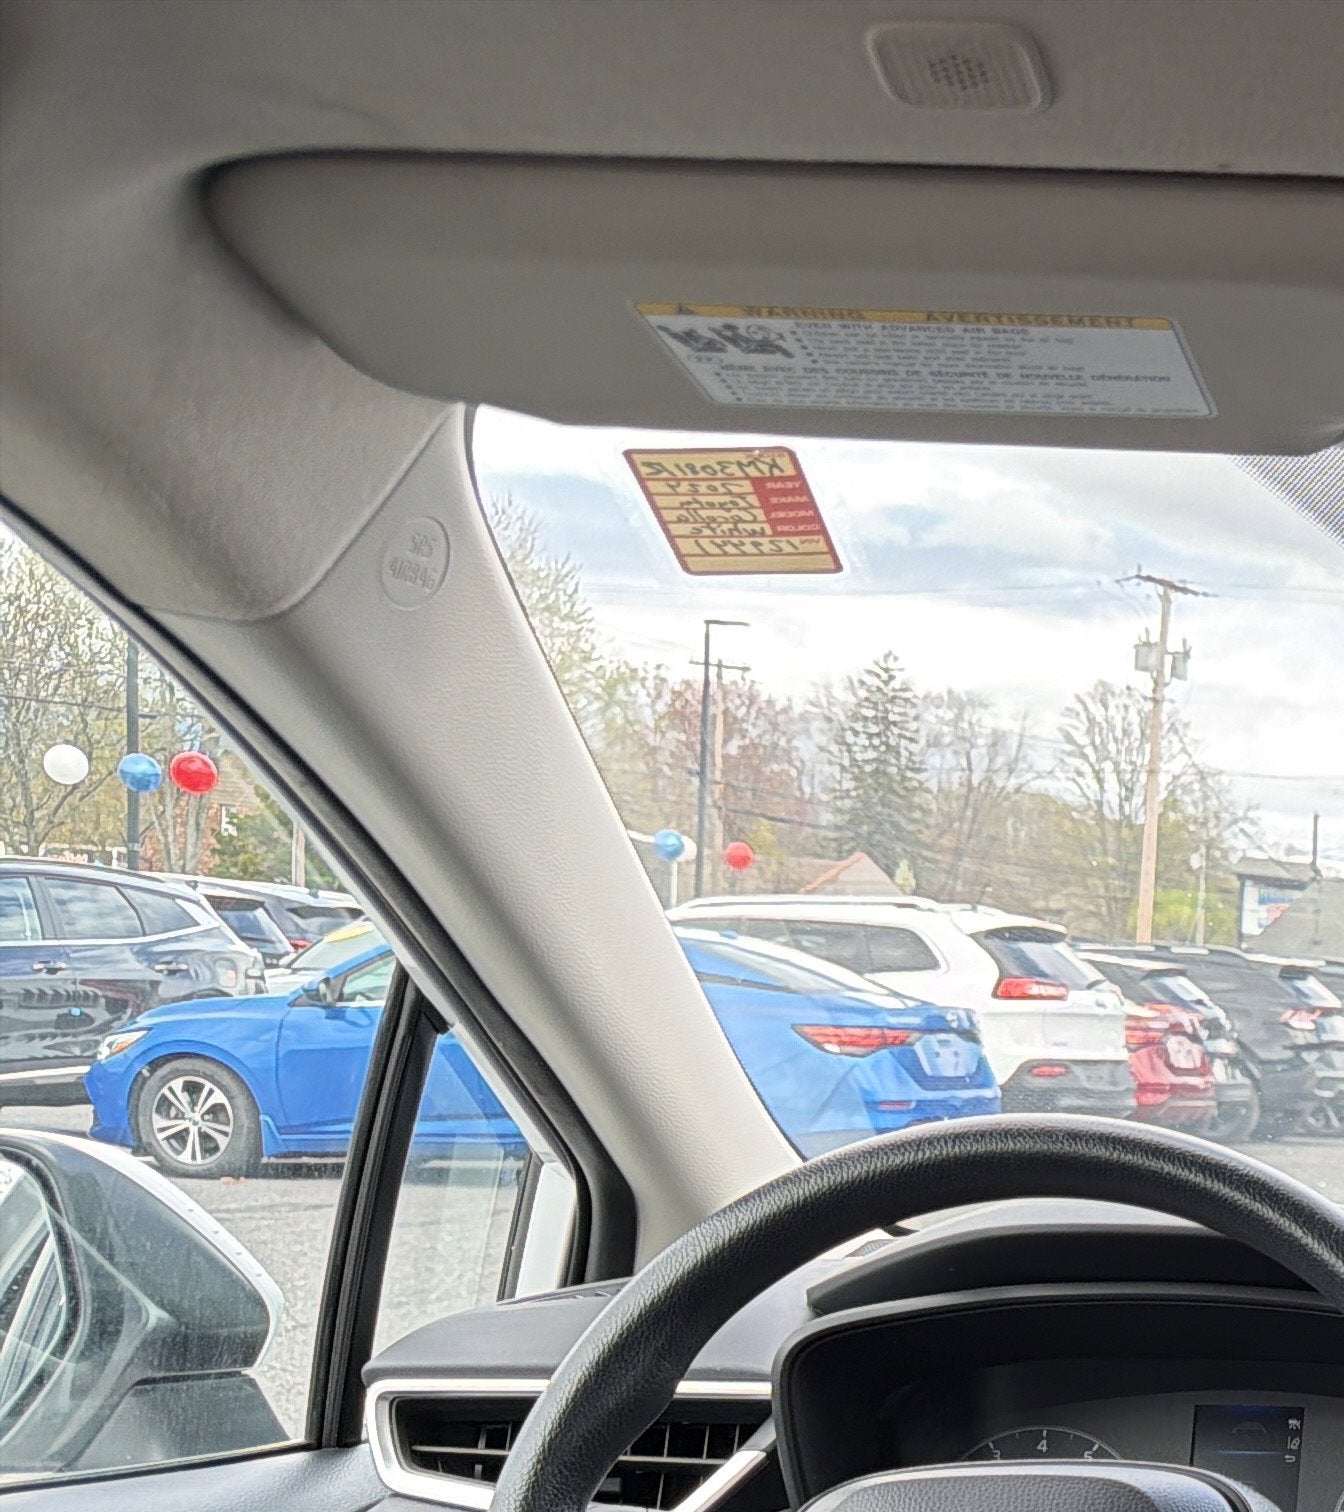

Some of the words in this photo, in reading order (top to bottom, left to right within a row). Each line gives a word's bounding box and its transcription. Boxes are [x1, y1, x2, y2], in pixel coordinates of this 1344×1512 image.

[747, 306, 861, 320] WARNING
[926, 312, 1133, 328] AVERTISSEMENT
[1036, 1439, 1048, 1453] 4
